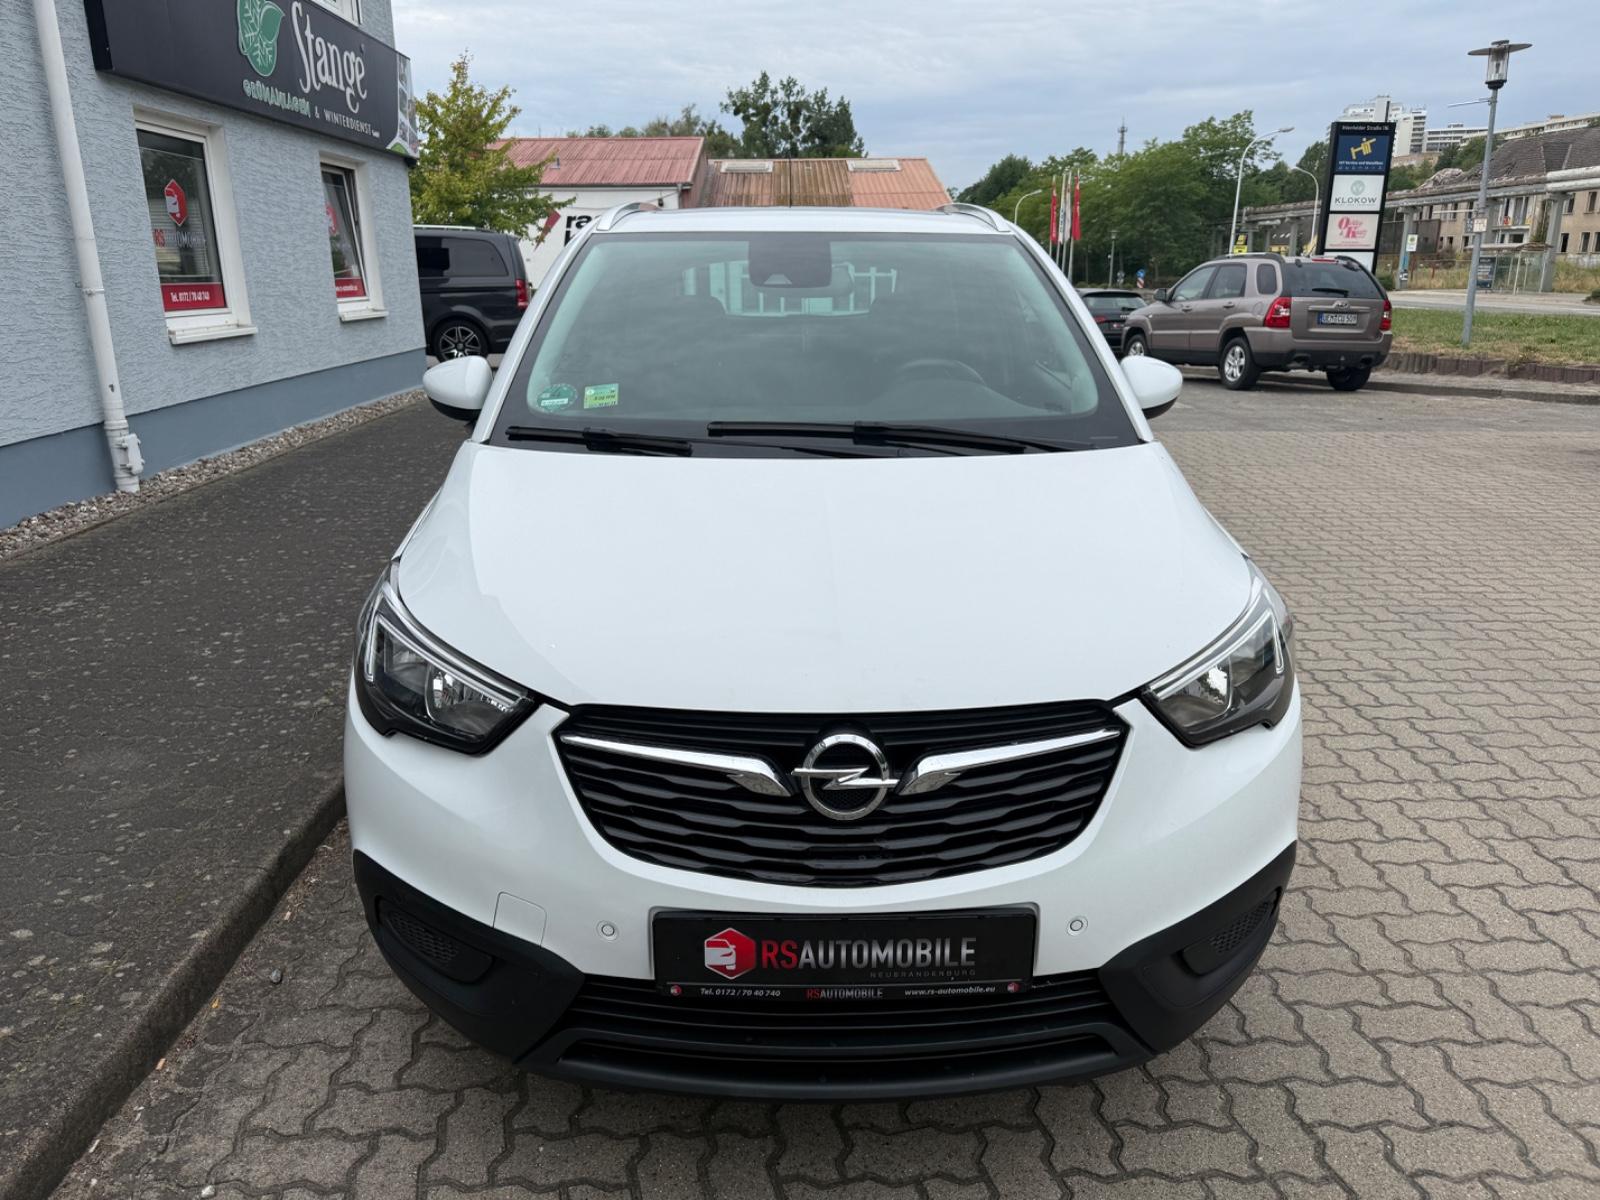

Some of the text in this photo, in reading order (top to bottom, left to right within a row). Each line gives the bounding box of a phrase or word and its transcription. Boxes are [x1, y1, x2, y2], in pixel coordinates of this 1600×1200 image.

[292, 1, 367, 114] Stange
[314, 105, 320, 119] &
[323, 108, 371, 136] WINTERDIENST
[1334, 196, 1378, 204] KLOKOW
[761, 937, 977, 969] RSAUTOMOBILE
[869, 969, 977, 979] NEUBRANDENBURG
[701, 988, 714, 996] Tel.
[742, 989, 751, 997] 70
[806, 988, 884, 999] RSAUTOMOBILE
[904, 986, 996, 996] www.rs-automobile.eu
